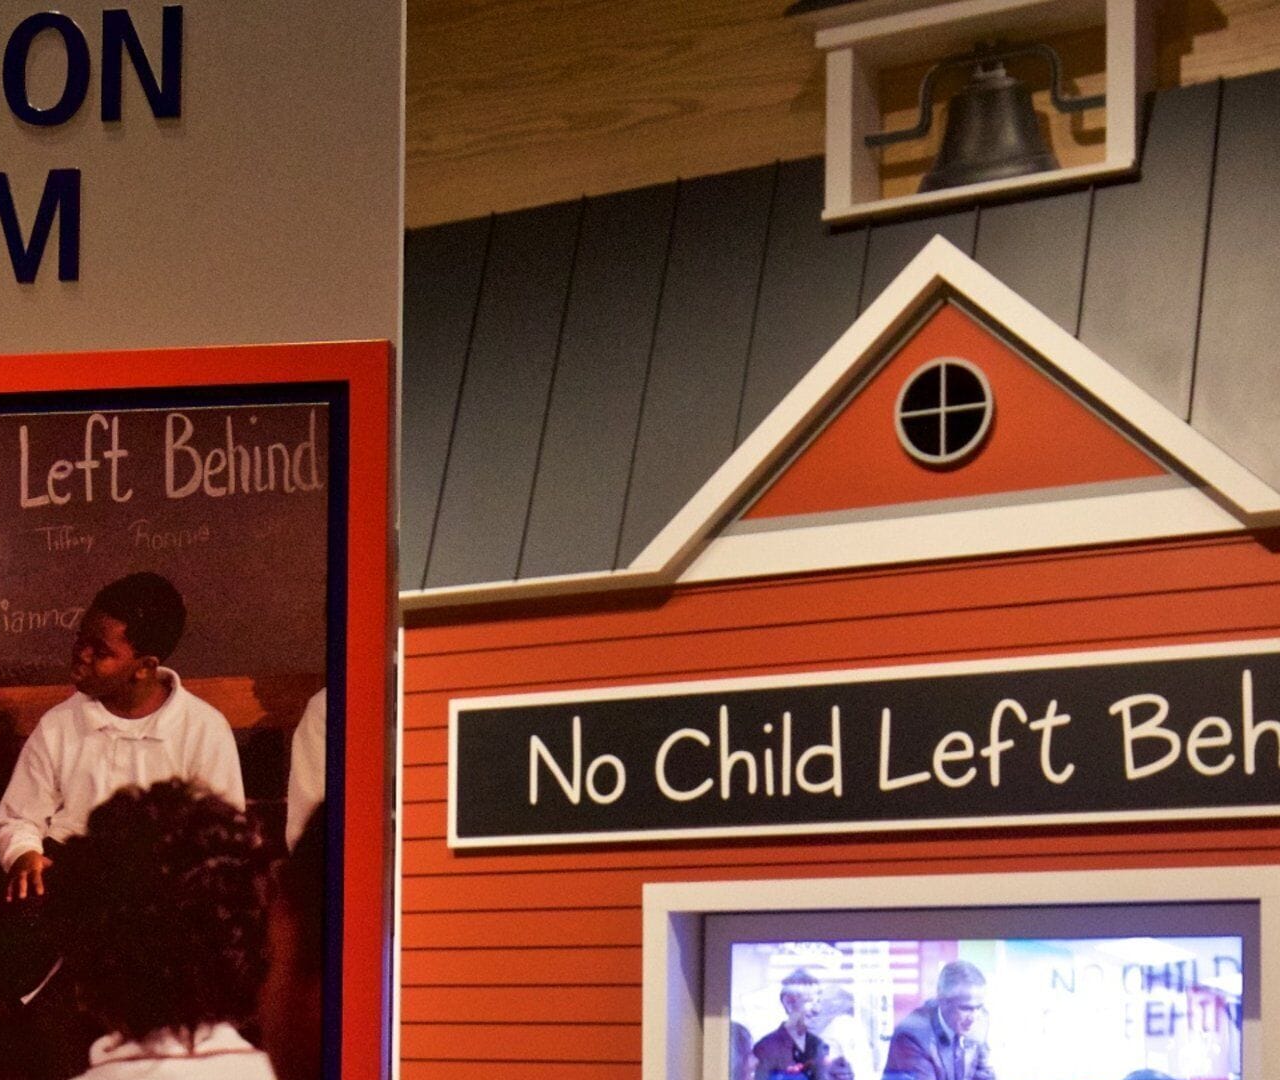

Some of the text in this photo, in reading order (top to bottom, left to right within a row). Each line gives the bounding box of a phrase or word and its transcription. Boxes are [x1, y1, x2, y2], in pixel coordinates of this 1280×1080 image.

[19, 413, 134, 508] Left
[165, 408, 324, 499] Behind
[529, 715, 627, 805] No
[655, 705, 844, 802] Child
[879, 699, 1074, 791] Left
